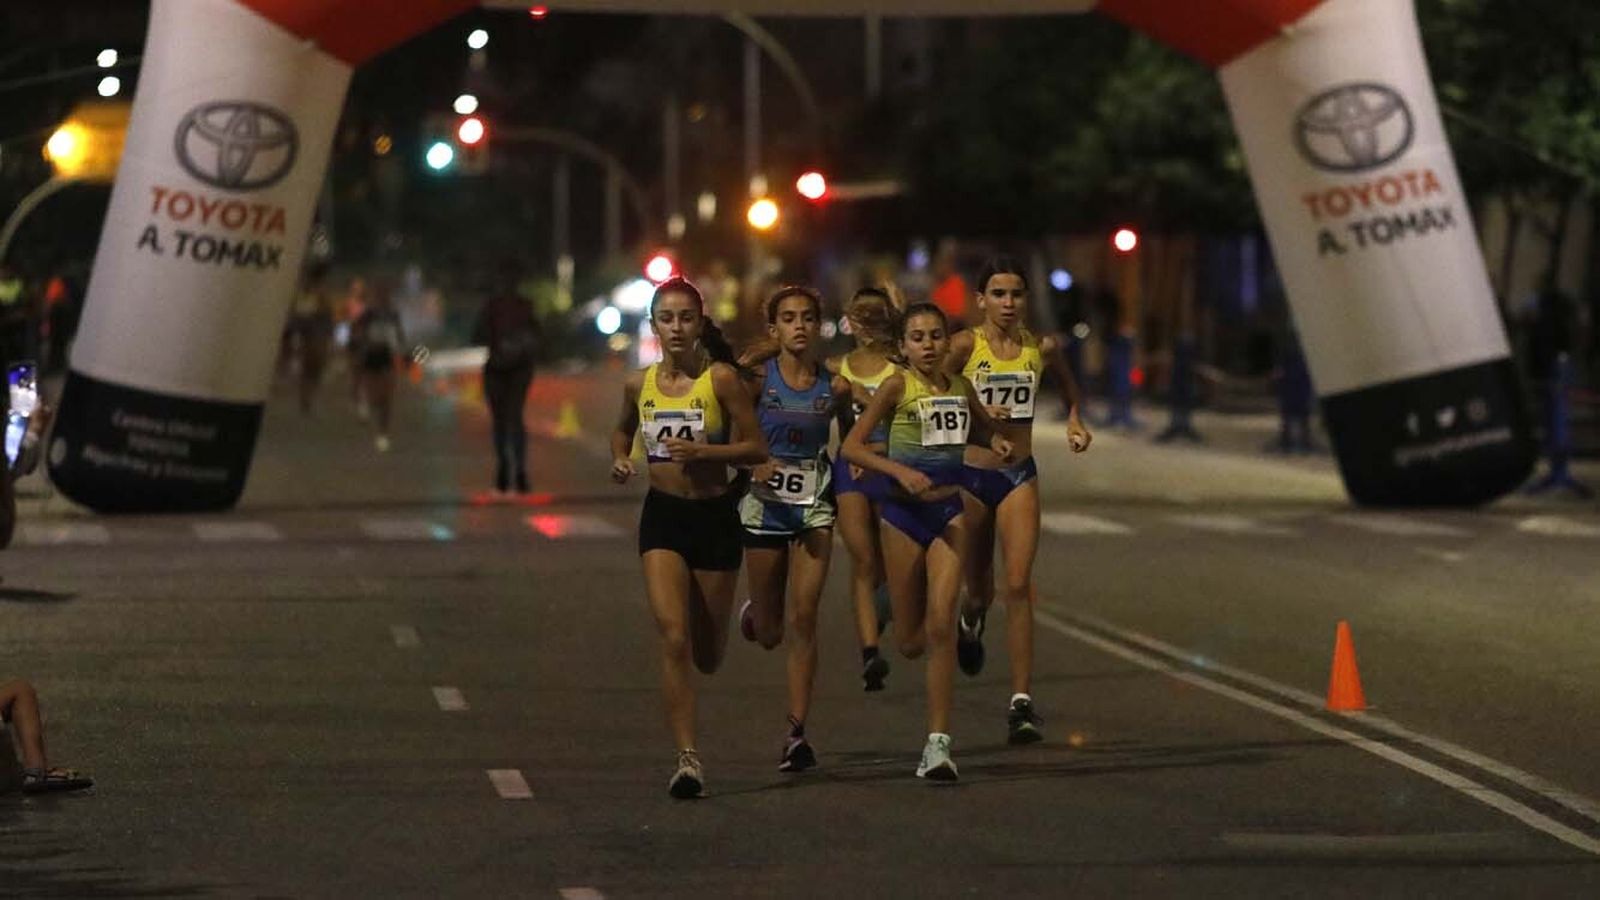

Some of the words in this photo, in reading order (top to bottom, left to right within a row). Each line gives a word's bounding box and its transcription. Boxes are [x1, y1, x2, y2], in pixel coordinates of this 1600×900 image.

[151, 185, 286, 235] TOYOTA
[1301, 169, 1441, 221] TOYOTA
[1350, 208, 1456, 248] TOMAX
[174, 229, 284, 269] TOMAX
[980, 386, 1030, 405] 170
[656, 425, 695, 443] 44
[930, 411, 968, 431] 187
[767, 472, 804, 493] 96
